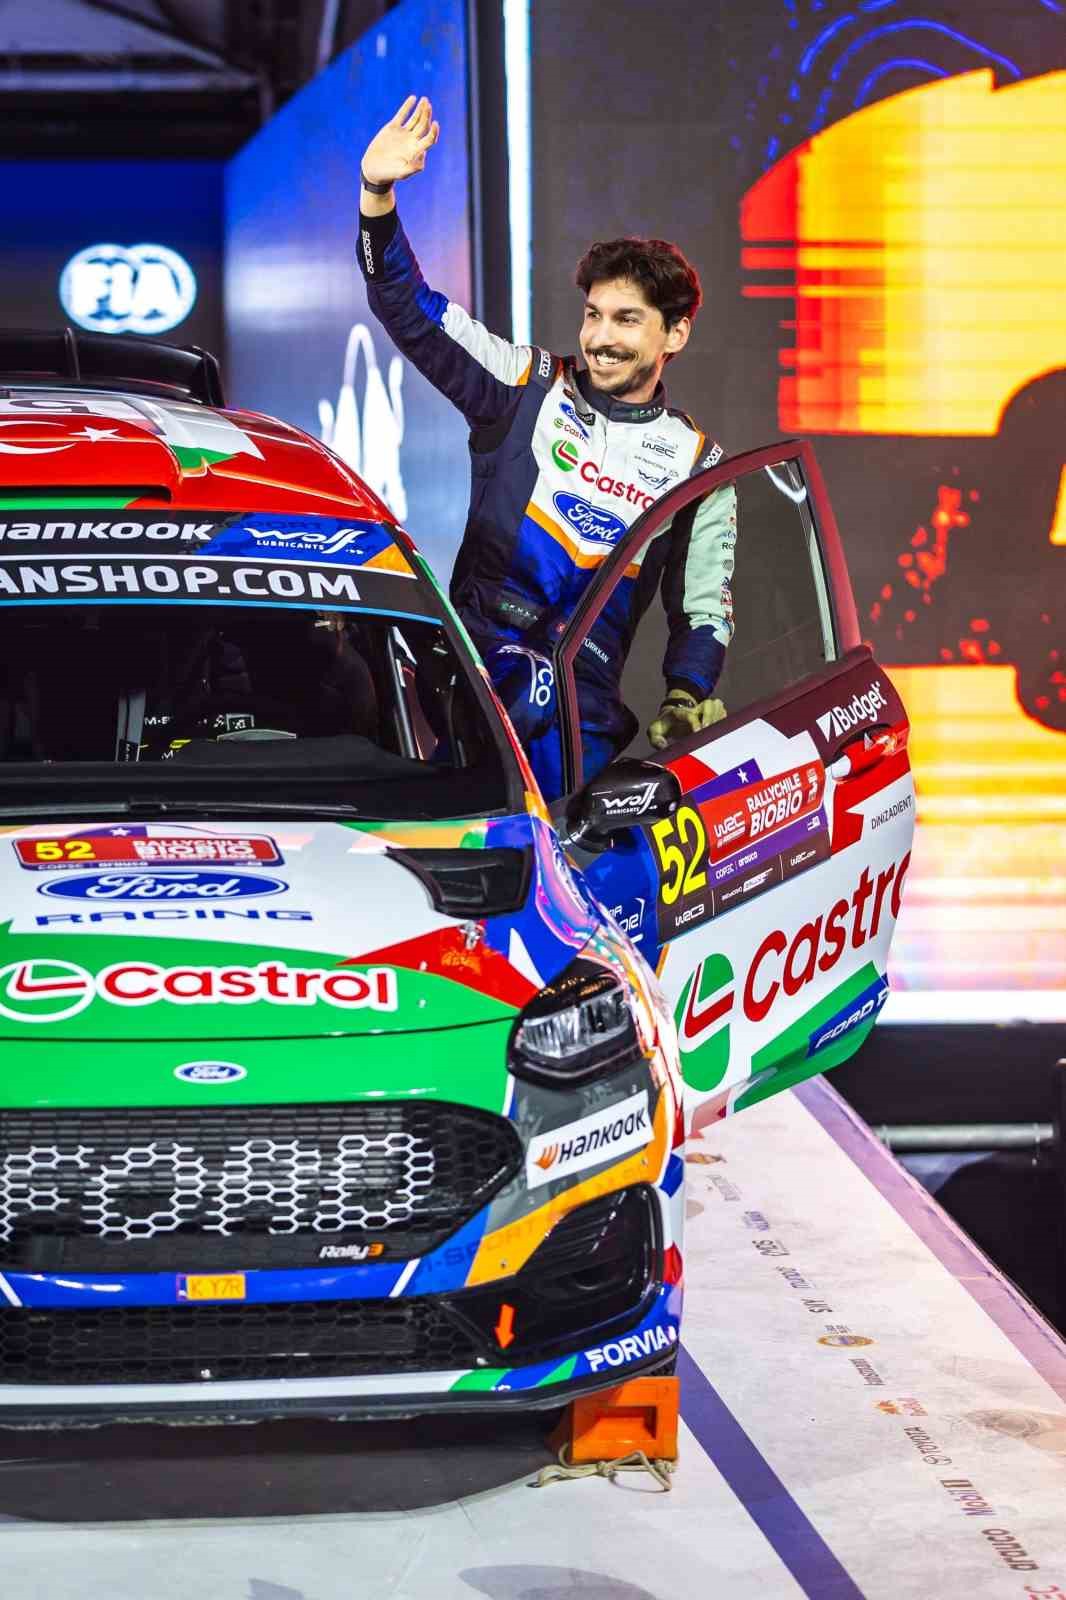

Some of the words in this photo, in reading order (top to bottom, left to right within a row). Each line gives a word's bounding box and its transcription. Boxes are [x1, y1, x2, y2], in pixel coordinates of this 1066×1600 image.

[73, 262, 180, 317] FIA
[641, 440, 676, 459] WRC
[256, 540, 325, 550] LUBRICANTS
[832, 683, 888, 732] Budget
[746, 772, 801, 812] RALLYCHILE
[713, 811, 746, 838] WRC
[750, 790, 803, 838] BIOBIO
[36, 841, 96, 860] 52
[651, 806, 706, 905] 52
[35, 908, 313, 926] RACING
[675, 903, 705, 927] WRC3
[103, 965, 389, 1004] Castrol
[814, 999, 875, 1049] FORD
[319, 1242, 385, 1261] Rally3
[584, 1325, 670, 1373] FORVIA
[903, 1426, 941, 1454] TOYOTA
[981, 1528, 1040, 1571] arauco
